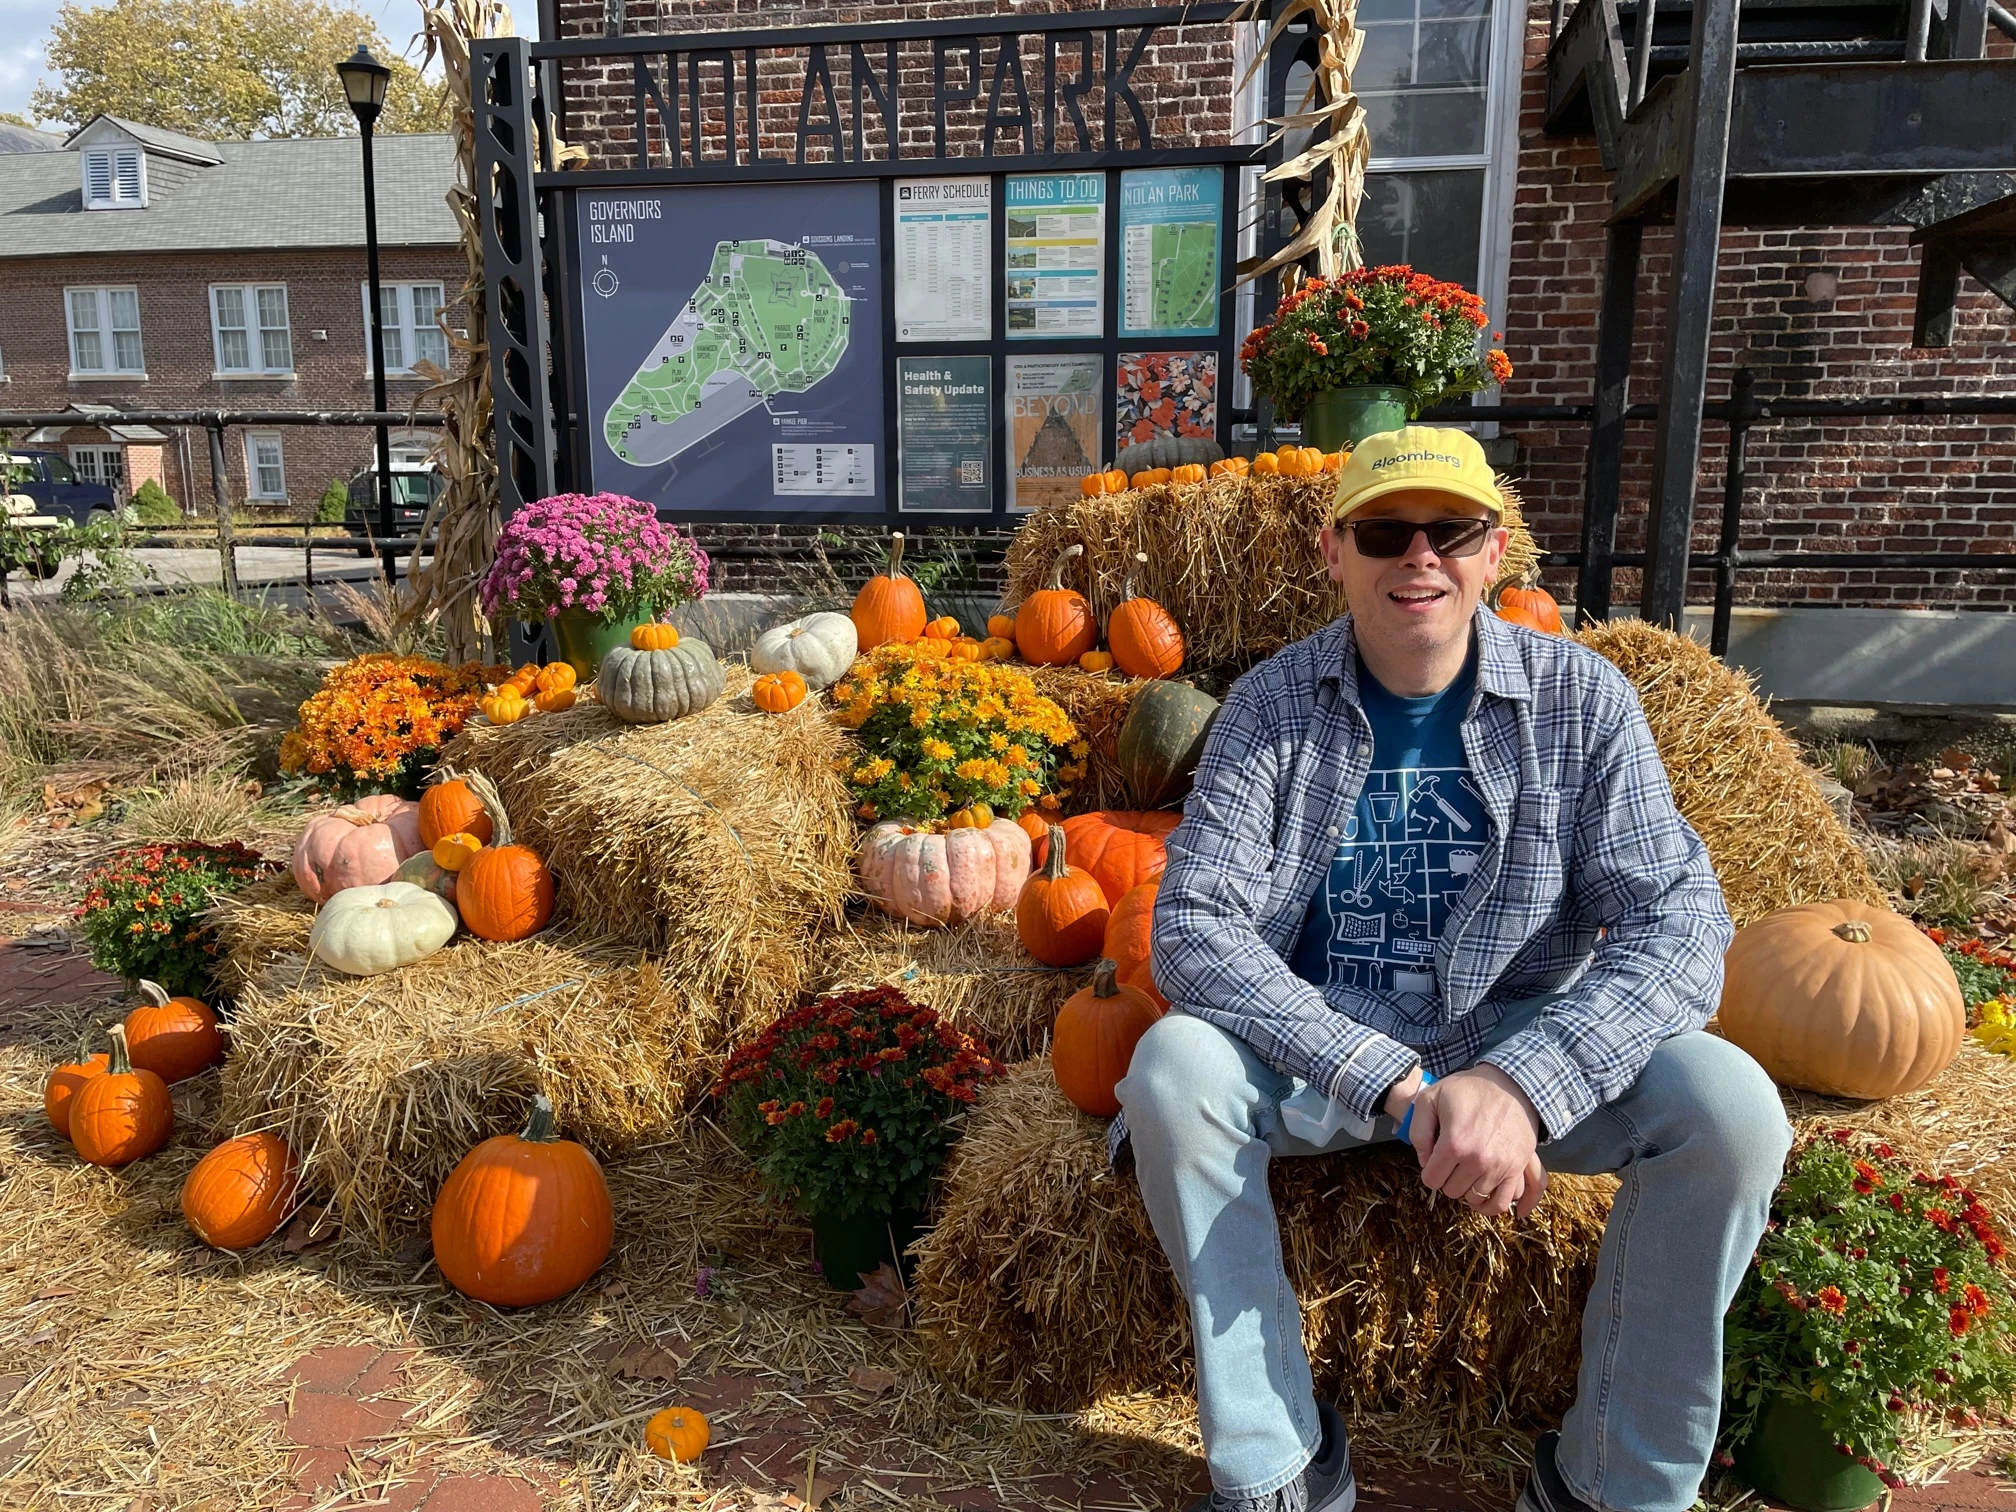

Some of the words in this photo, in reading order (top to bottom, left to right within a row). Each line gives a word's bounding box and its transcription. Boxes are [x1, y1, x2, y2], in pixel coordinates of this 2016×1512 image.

[633, 41, 898, 169] NOLAN
[934, 27, 1153, 159] PARK
[913, 185, 940, 200] FERRY
[943, 183, 990, 199] SCHEDULE
[1009, 180, 1054, 200] THINGS
[1059, 180, 1075, 199] TO
[1080, 179, 1098, 198] DO
[1124, 186, 1164, 206] NOLAN
[1168, 183, 1200, 203] PARK
[589, 200, 662, 221] GOVERNORS
[590, 223, 635, 243] ISLAND
[601, 254, 608, 266] N
[904, 370, 941, 381] Health
[943, 370, 953, 381] &
[904, 384, 942, 396] Safety
[944, 384, 985, 396] Update
[1012, 394, 1097, 417] BEYOND
[1371, 449, 1461, 471] Bloomberg
[1015, 465, 1055, 478] BUSINESS
[1055, 466, 1068, 478] AS
